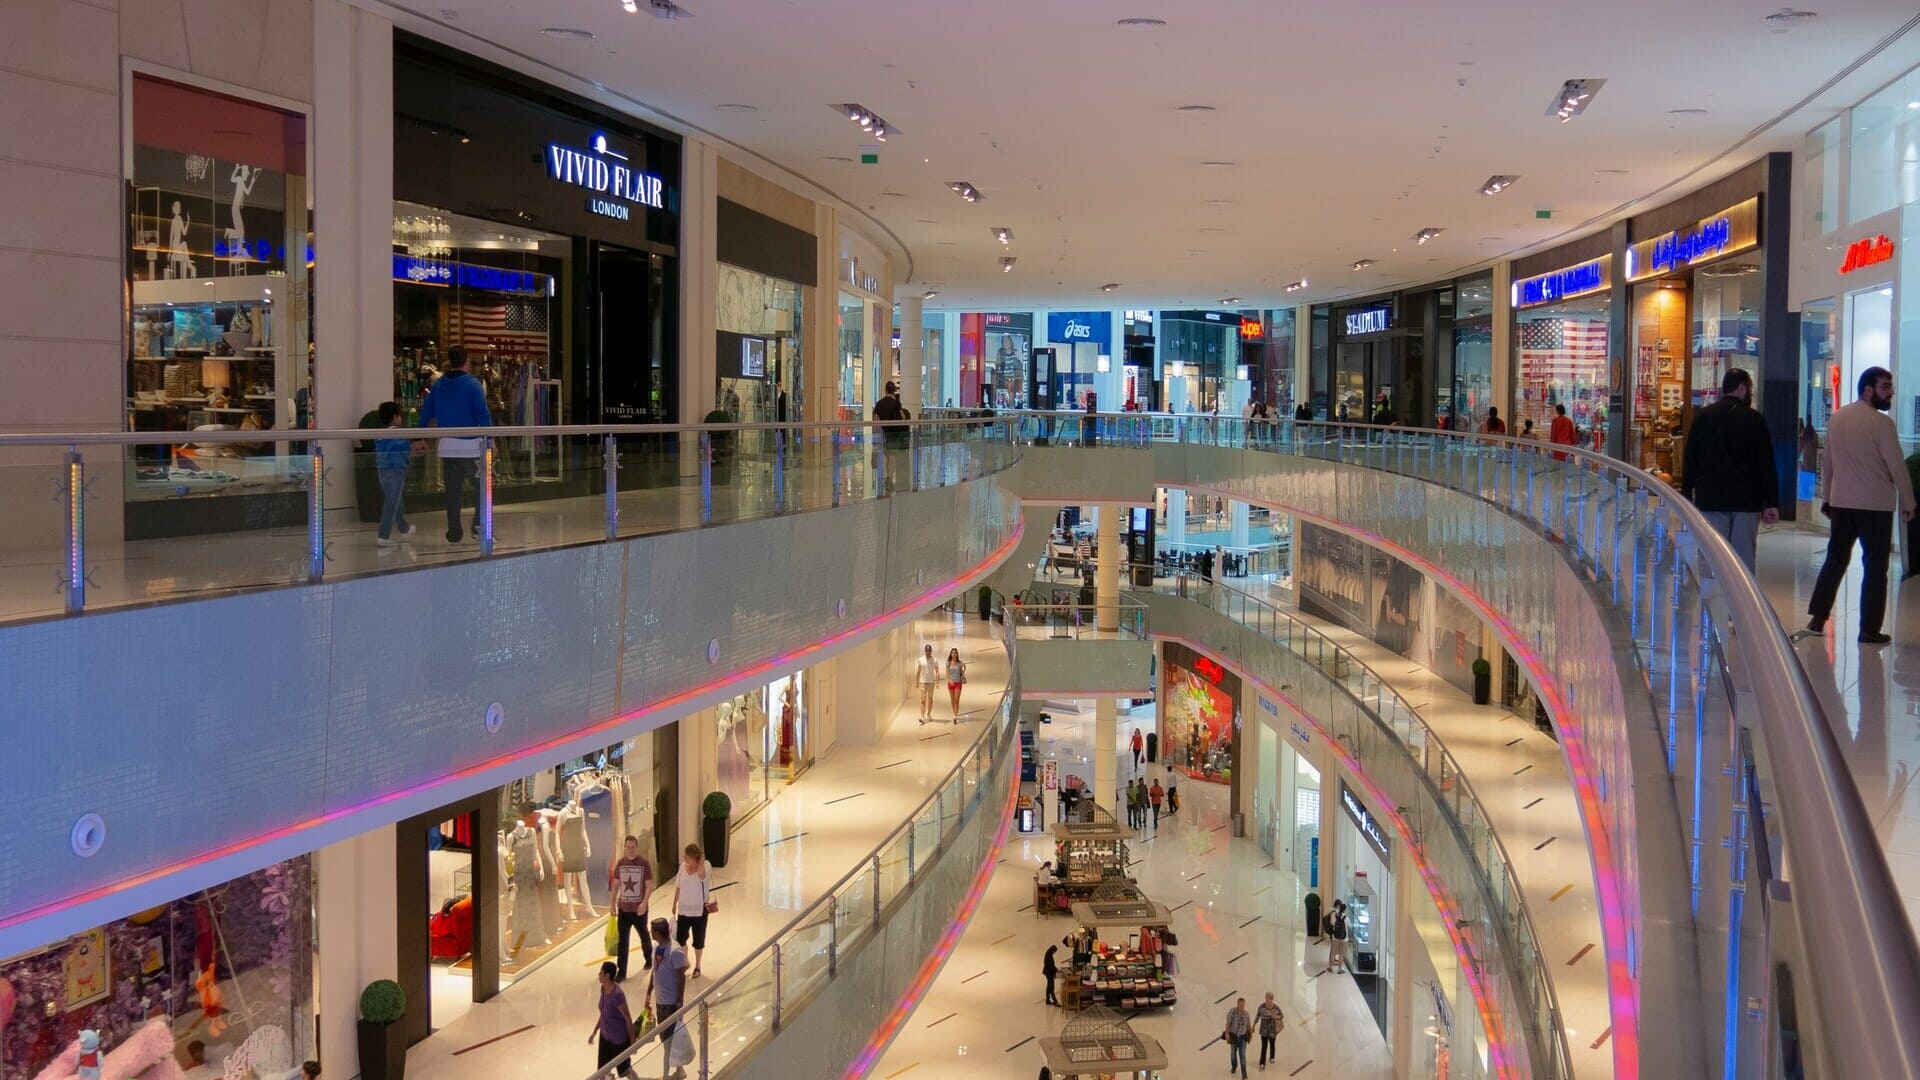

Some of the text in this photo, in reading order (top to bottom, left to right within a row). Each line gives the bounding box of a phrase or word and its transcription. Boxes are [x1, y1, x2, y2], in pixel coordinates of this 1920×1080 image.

[551, 145, 664, 209] VIVID FLAIR
[592, 198, 629, 221] LONDON
[1345, 309, 1387, 336] STADIUM
